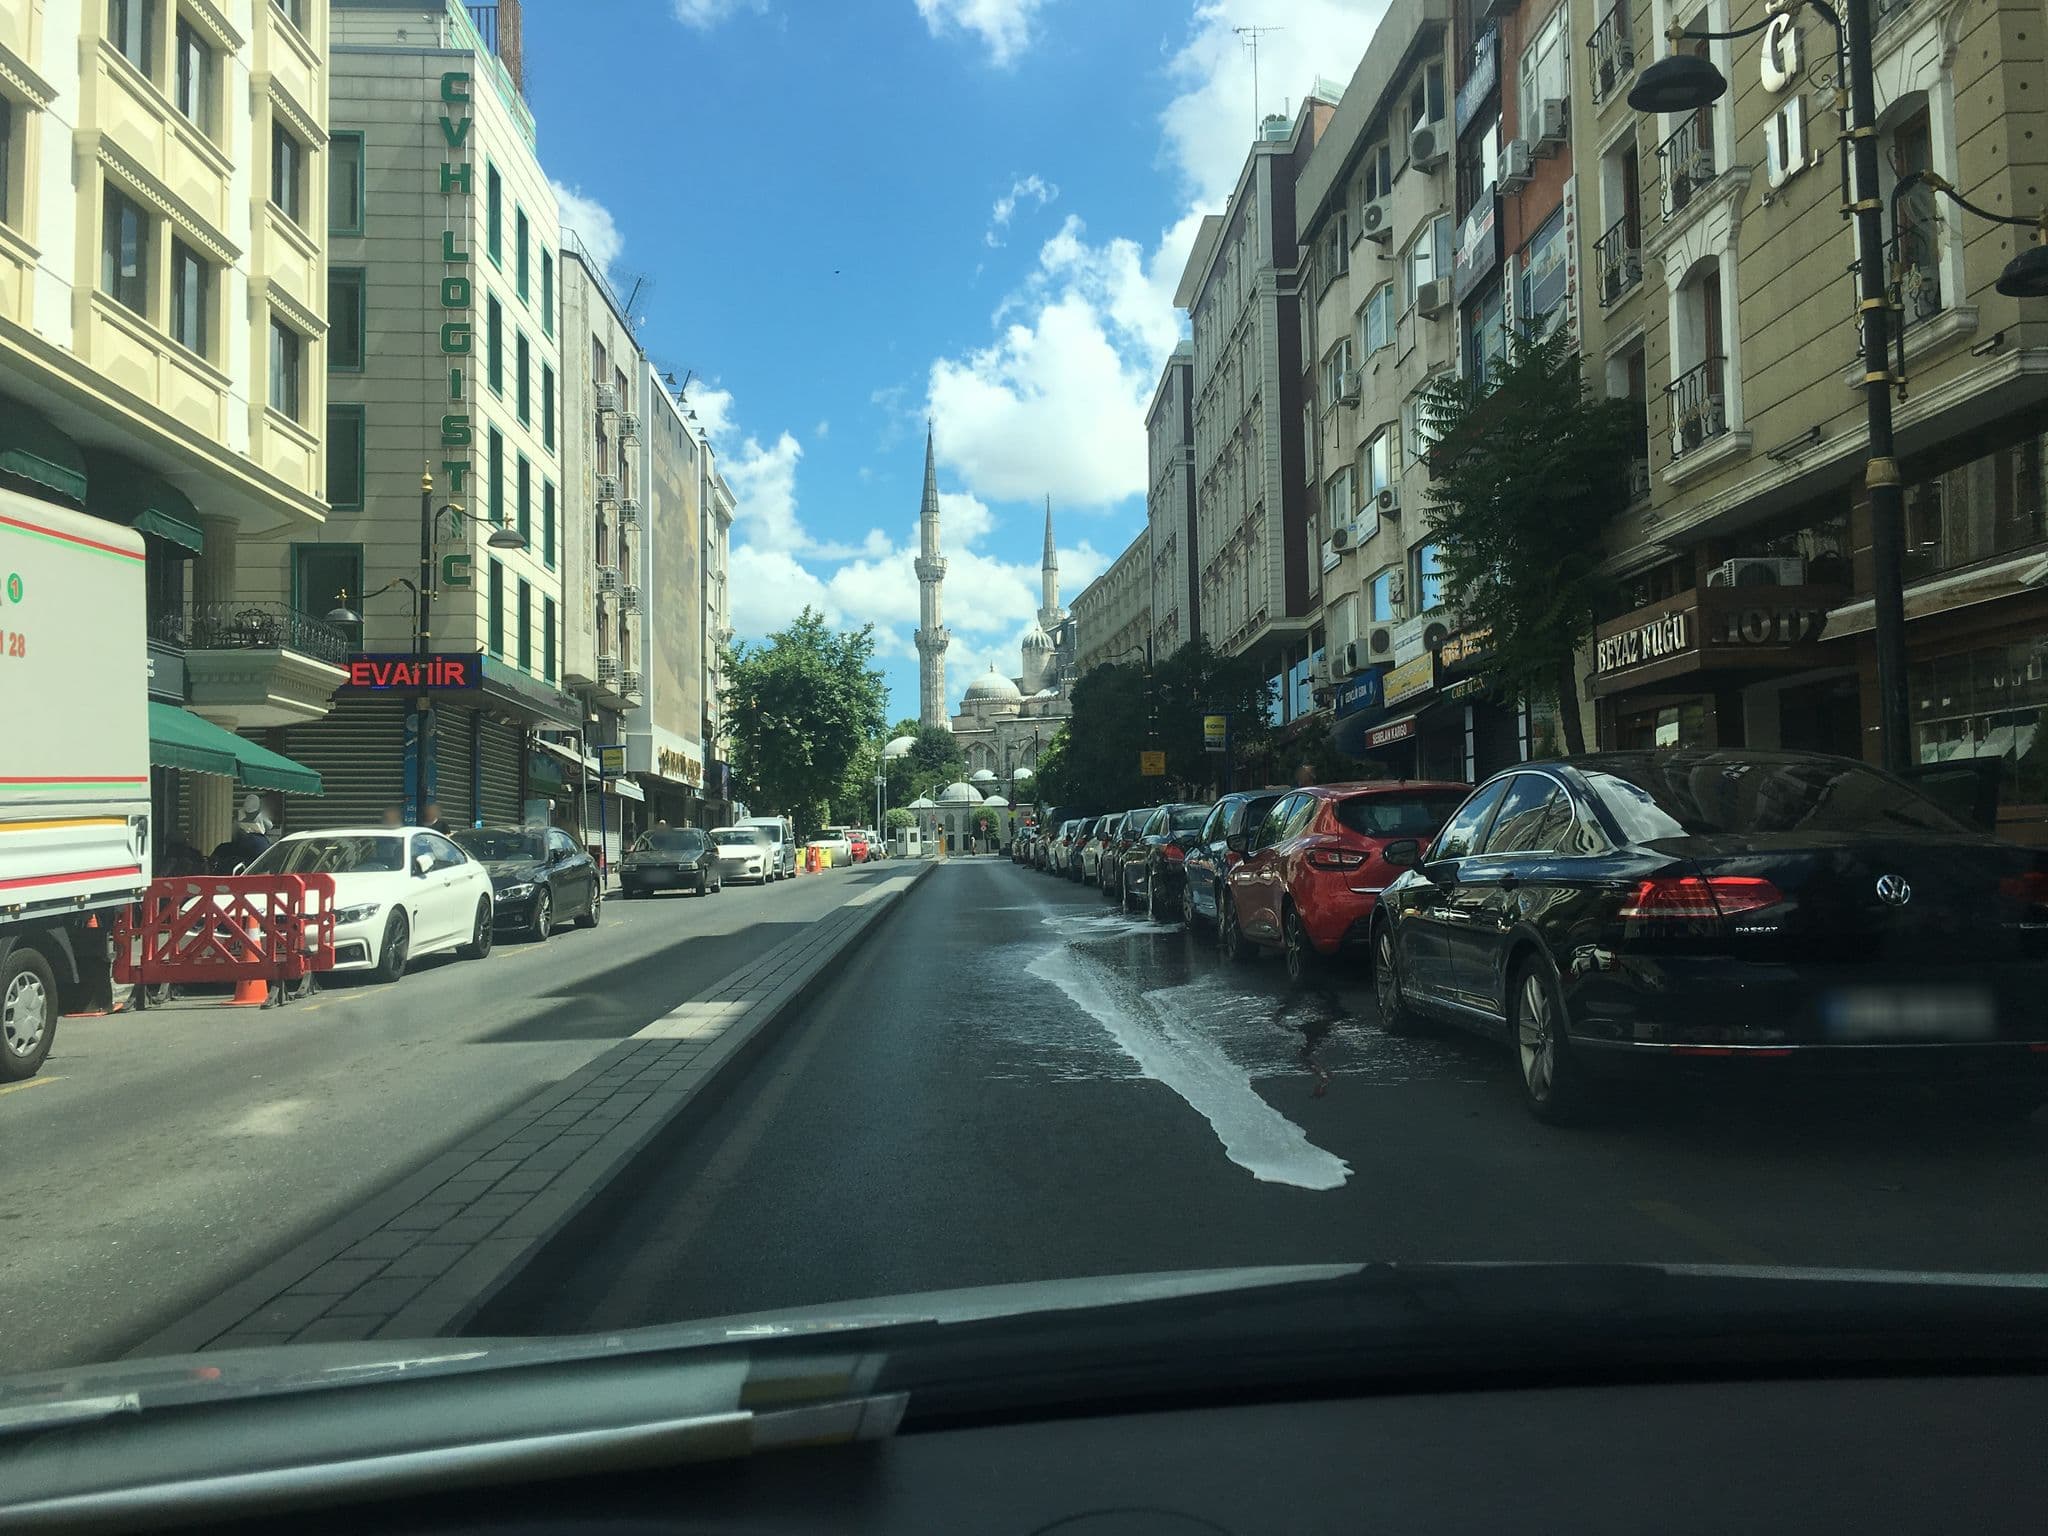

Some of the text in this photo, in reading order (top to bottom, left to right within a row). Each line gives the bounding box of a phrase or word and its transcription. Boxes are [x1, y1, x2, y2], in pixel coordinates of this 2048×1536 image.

[439, 71, 474, 586] CVH LOGISTIC
[9, 632, 25, 657] 28
[1597, 611, 1686, 673] BEYAZ KUĞU
[1391, 723, 1408, 739] KARGO
[1735, 926, 1778, 934] PASSAT
